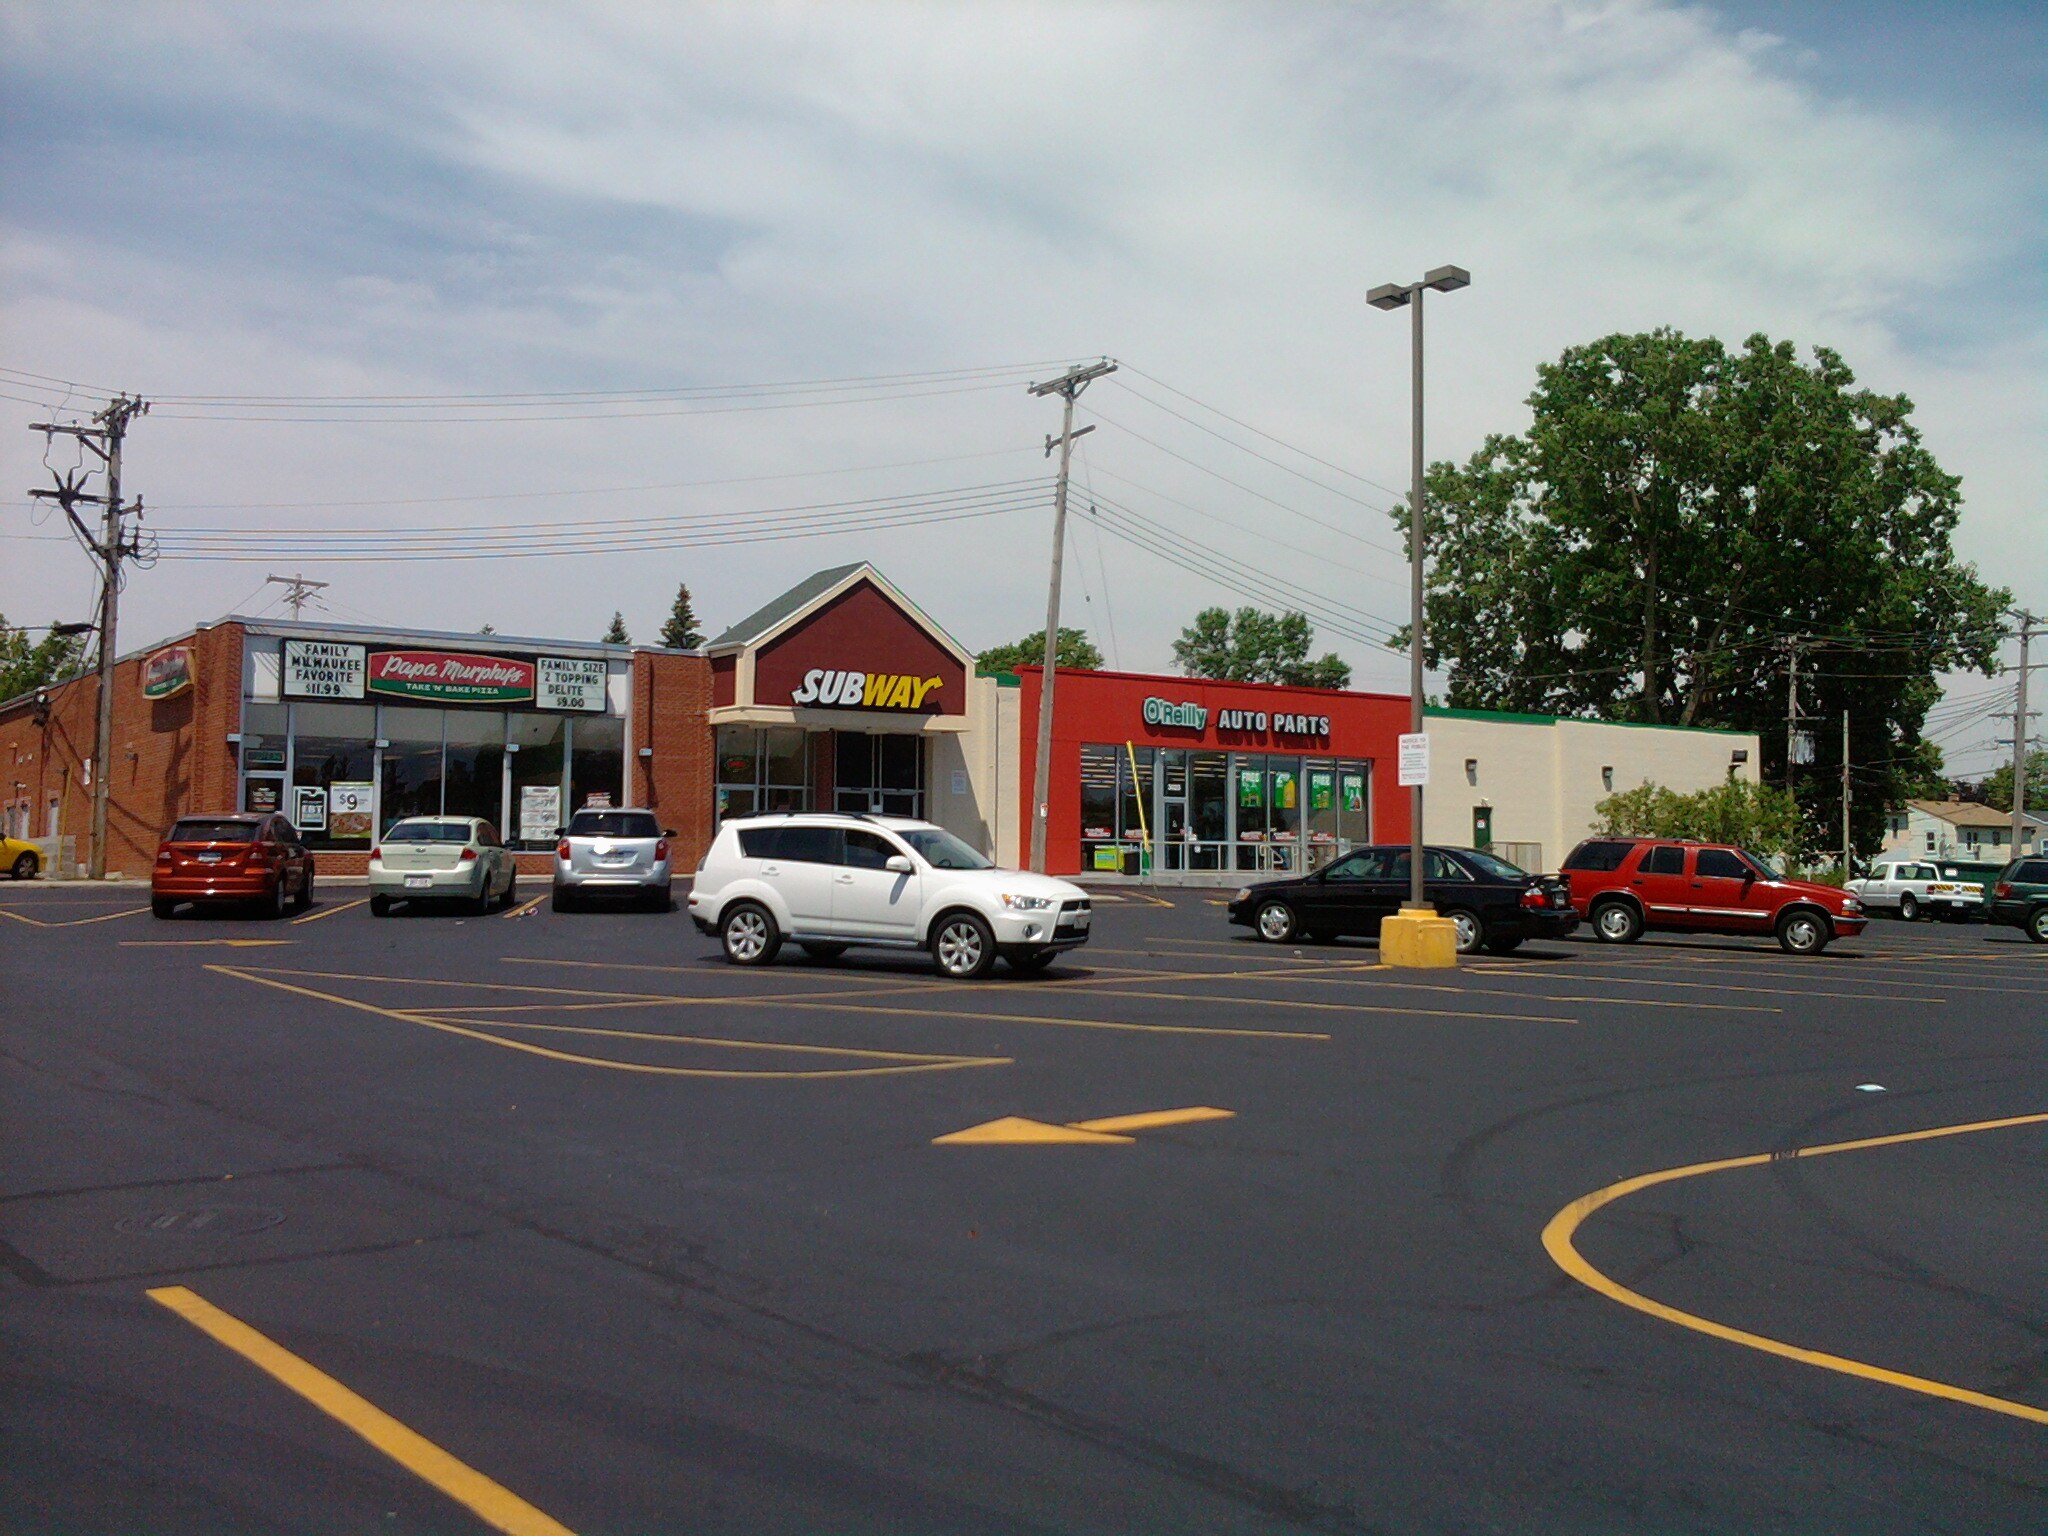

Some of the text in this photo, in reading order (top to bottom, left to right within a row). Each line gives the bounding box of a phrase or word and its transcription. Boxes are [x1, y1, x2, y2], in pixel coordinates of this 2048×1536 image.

[305, 644, 349, 657] FAMILY
[292, 656, 360, 671] MILWAUKEE
[380, 655, 438, 680] Papa
[540, 659, 604, 673] FAMILY SIZE
[296, 669, 353, 683] FAVORITE
[544, 671, 599, 685] 2 TOPPING
[305, 683, 341, 695] $11.99
[406, 683, 430, 691] TAKE
[445, 684, 470, 693] BAKE
[472, 686, 499, 695] PIZZA
[548, 684, 584, 696] DELITE
[791, 668, 944, 709] SUBWAY
[557, 697, 585, 708] $9.00
[1144, 697, 1330, 735] O'Reilly AUTO PARTS
[339, 793, 358, 810] $9
